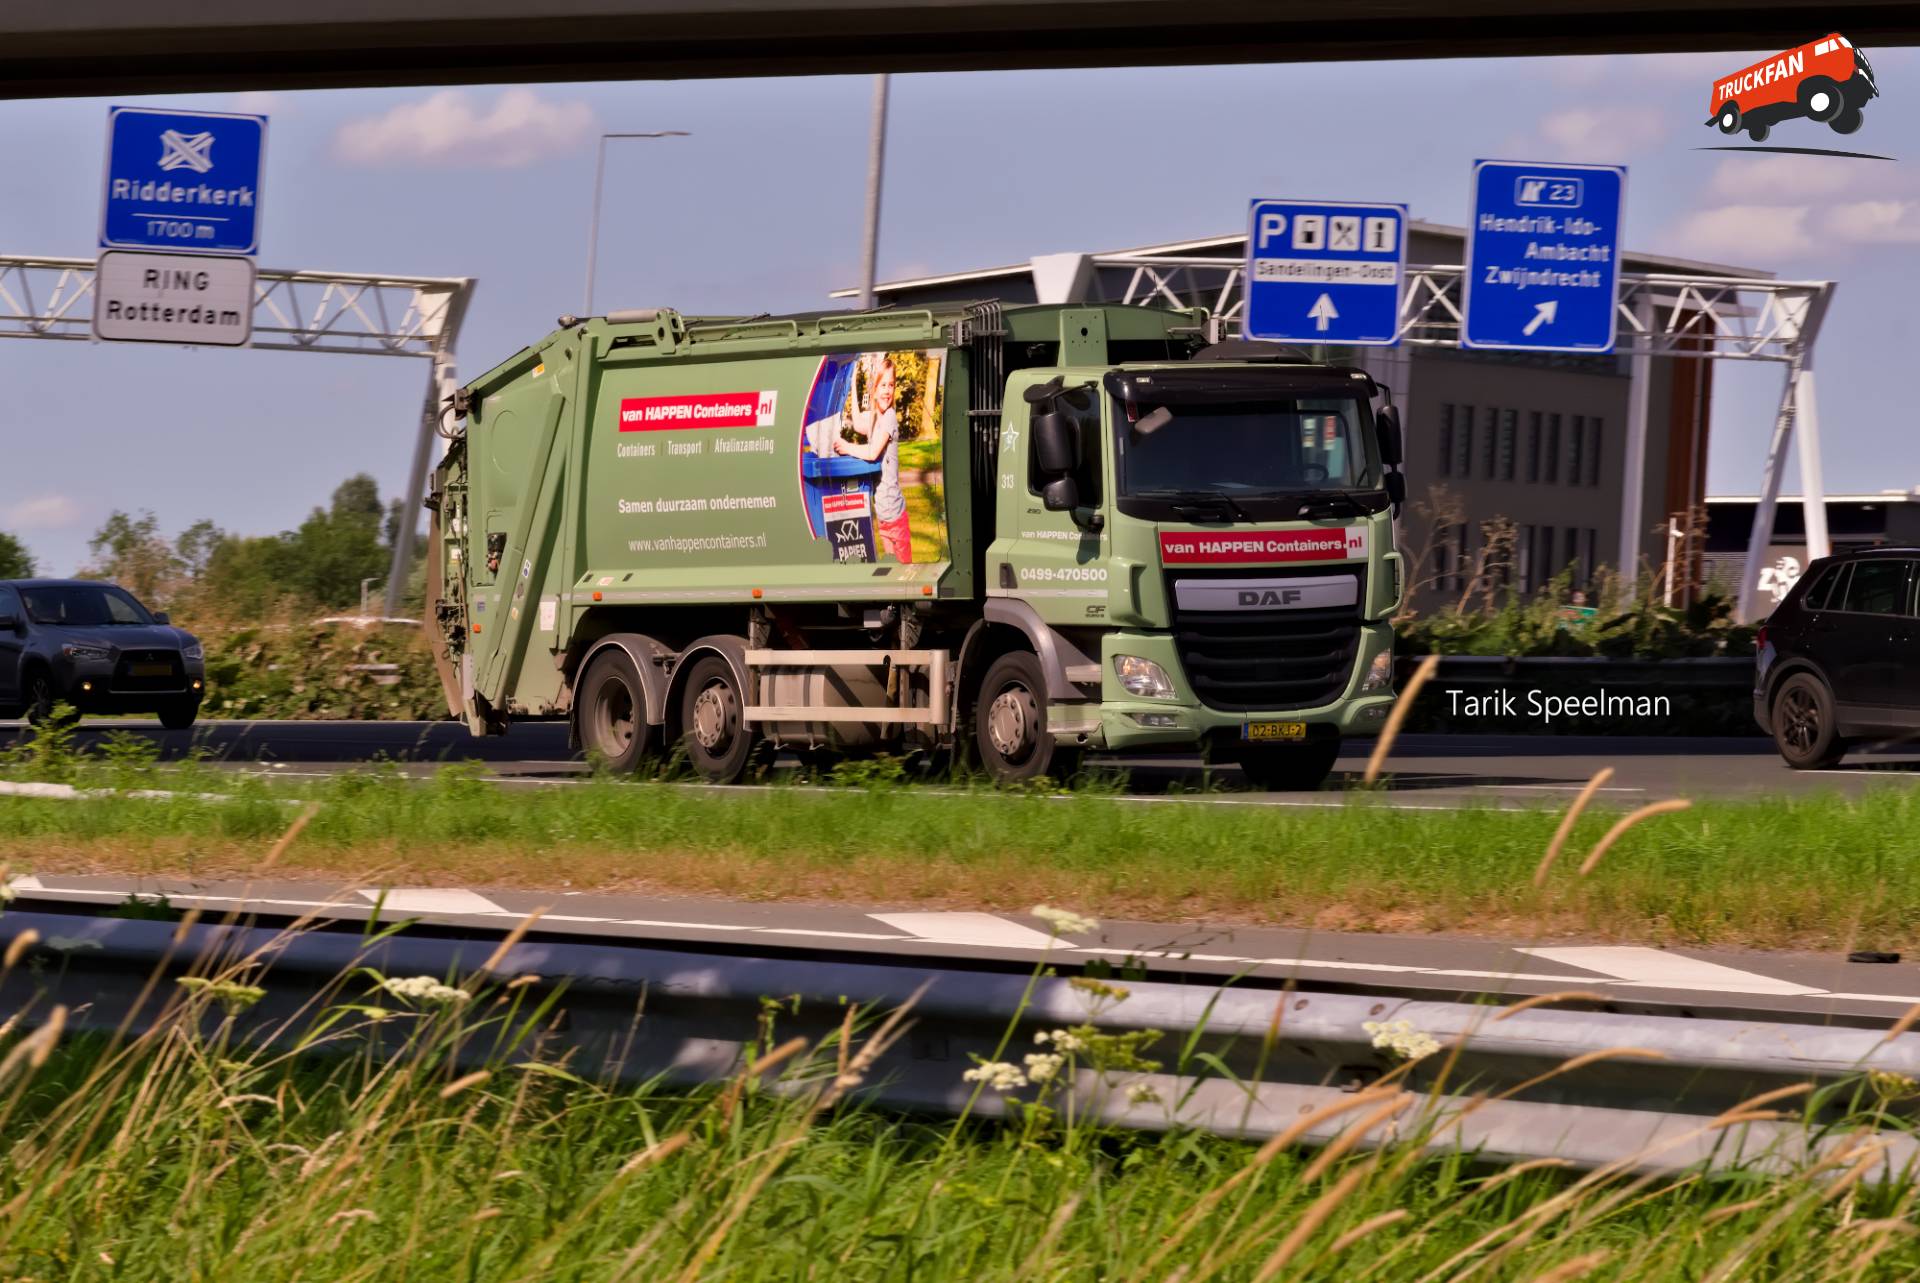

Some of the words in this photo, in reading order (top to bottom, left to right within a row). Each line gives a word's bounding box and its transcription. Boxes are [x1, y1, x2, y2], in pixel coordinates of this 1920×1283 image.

[111, 178, 254, 207] Ridderkerk
[1548, 184, 1577, 201] 23
[1258, 213, 1288, 249] P
[1478, 212, 1603, 236] Hendrik-Ido-
[1523, 241, 1611, 263] Ambacht
[143, 268, 210, 291] RING
[1257, 261, 1394, 281] Sandelingen-Oost
[1483, 265, 1602, 291] Zwijndrecht
[105, 299, 241, 326] Rotterdam
[621, 409, 643, 422] van
[644, 404, 693, 421] HAPPEN
[617, 442, 656, 458] Containers
[667, 440, 702, 458] Transport
[714, 437, 775, 455] Afvalinzameling
[1001, 473, 1015, 489] 313
[618, 499, 654, 514] Samen
[656, 497, 707, 513] duurzaam
[710, 495, 776, 511] ondernemen
[628, 532, 768, 553] www.vanhappencontainers.nl
[1021, 530, 1036, 539] van
[1036, 530, 1069, 540] HAPPEN
[1164, 542, 1195, 554] van
[1199, 541, 1265, 554] HAPPEN
[1020, 567, 1108, 581] 0499-470500
[1237, 590, 1301, 606] DAF
